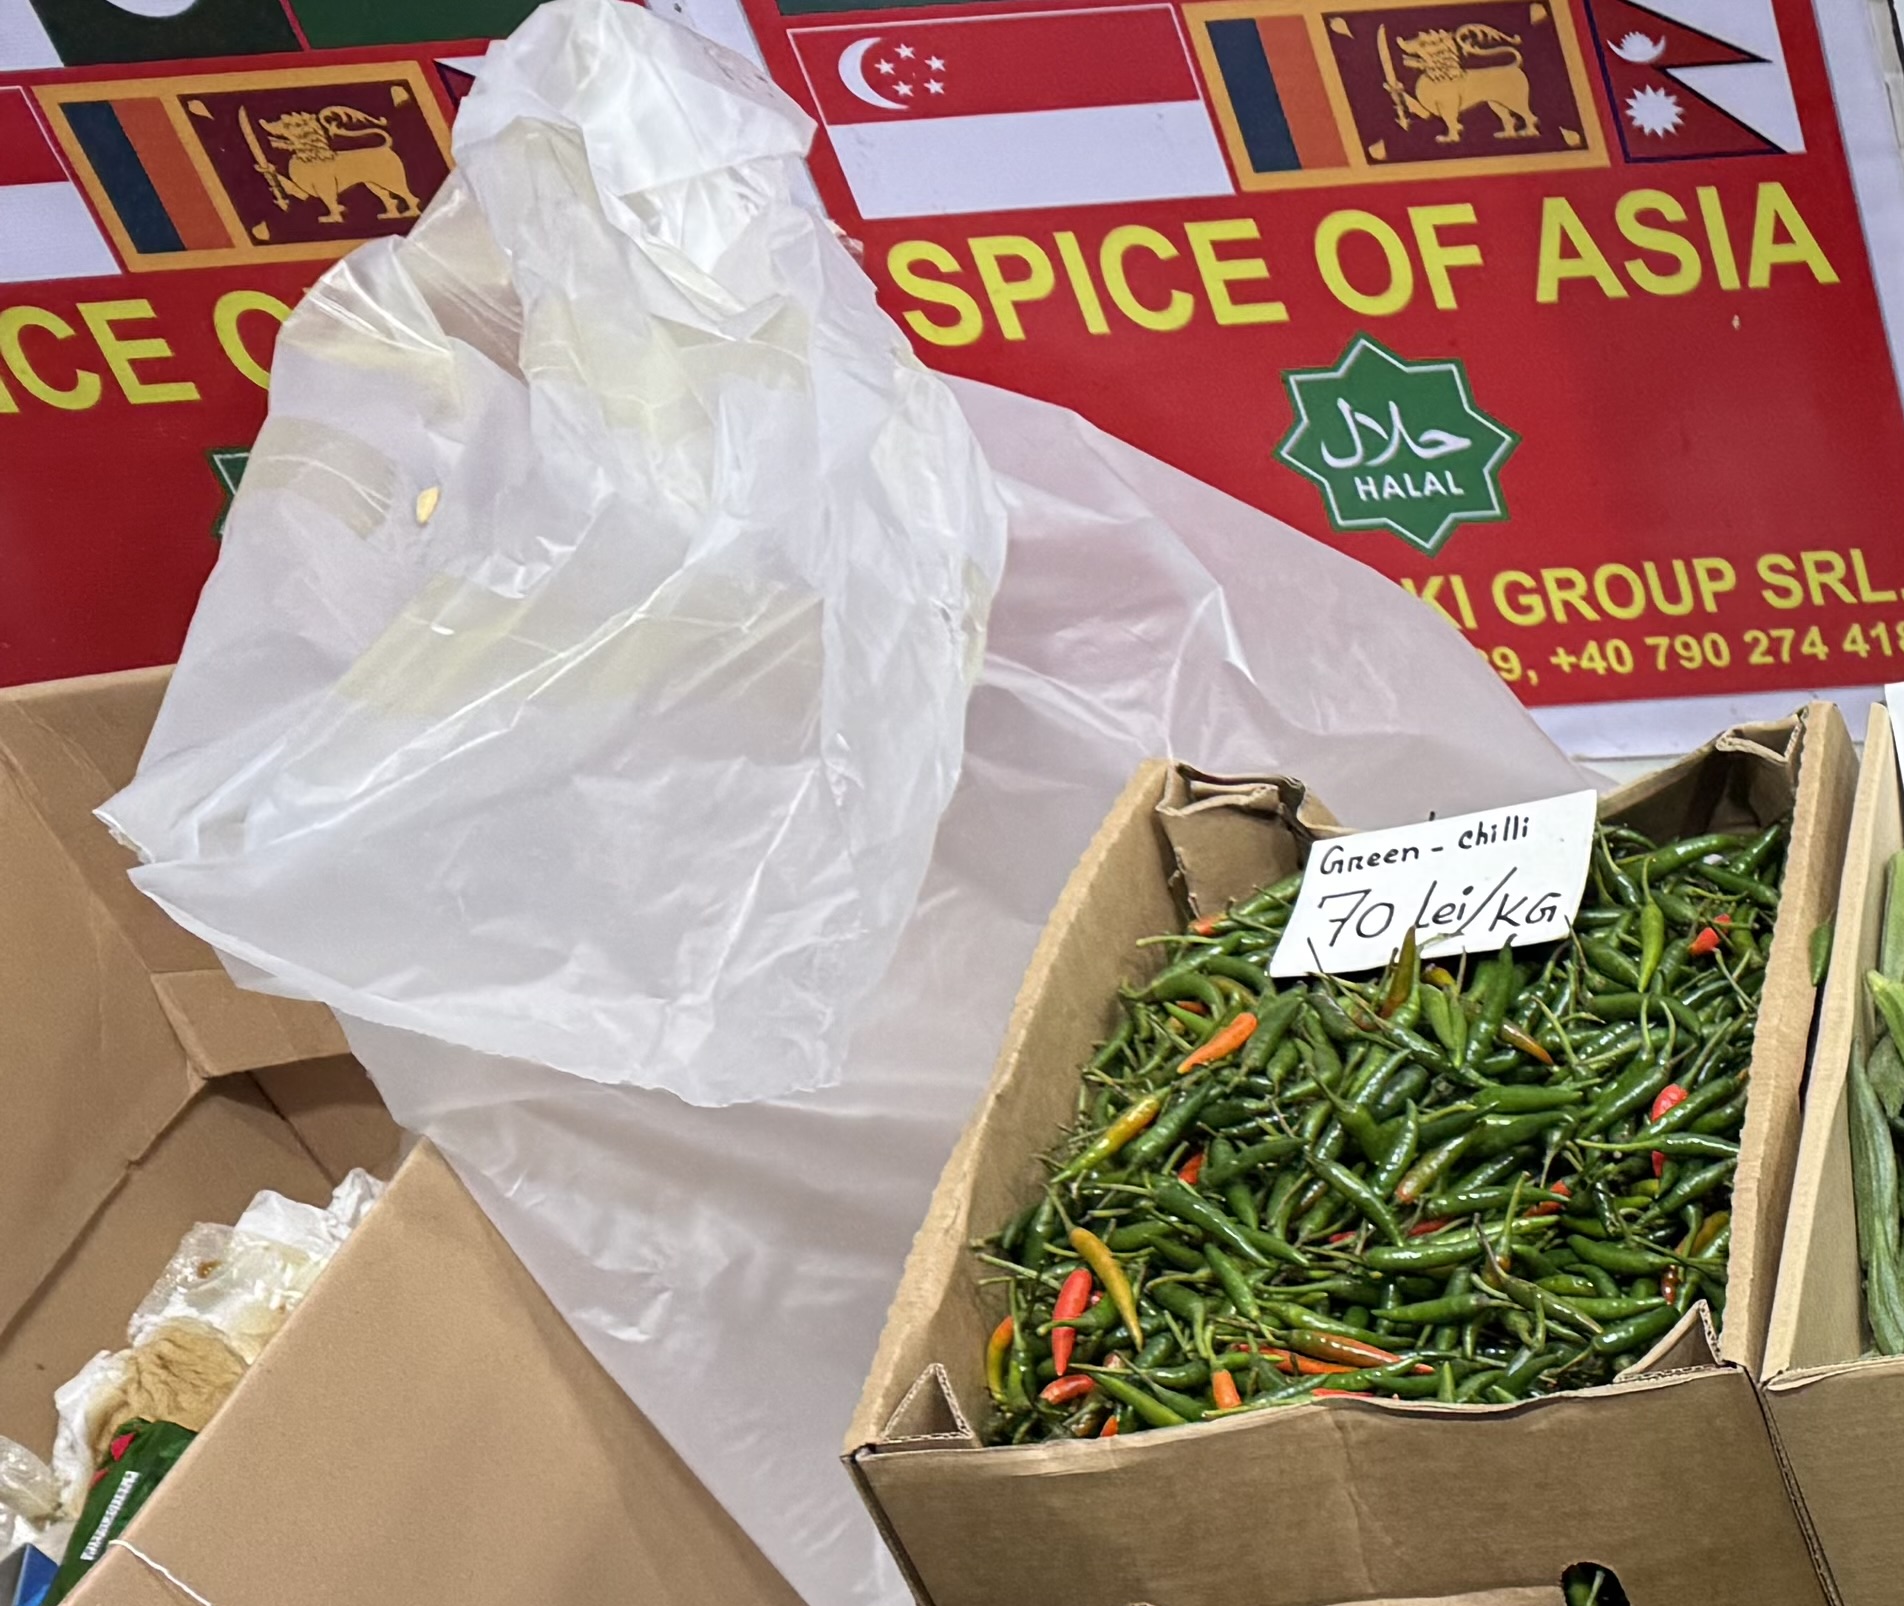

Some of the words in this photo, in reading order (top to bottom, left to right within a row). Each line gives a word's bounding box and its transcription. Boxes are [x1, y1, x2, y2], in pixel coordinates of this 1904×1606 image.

[886, 219, 1288, 347] SPICE
[1314, 202, 1483, 316] OF
[1536, 182, 1840, 303] ASIA
[1320, 397, 1472, 468] حلال
[1354, 470, 1465, 501] HALAL
[1491, 557, 1737, 627] GROUP
[1477, 646, 1539, 687] 9,
[1550, 638, 1635, 675] +40
[1644, 632, 1731, 671] 790
[1743, 626, 1828, 665] 274
[1319, 845, 1420, 876] Green
[1317, 888, 1396, 948] 70
